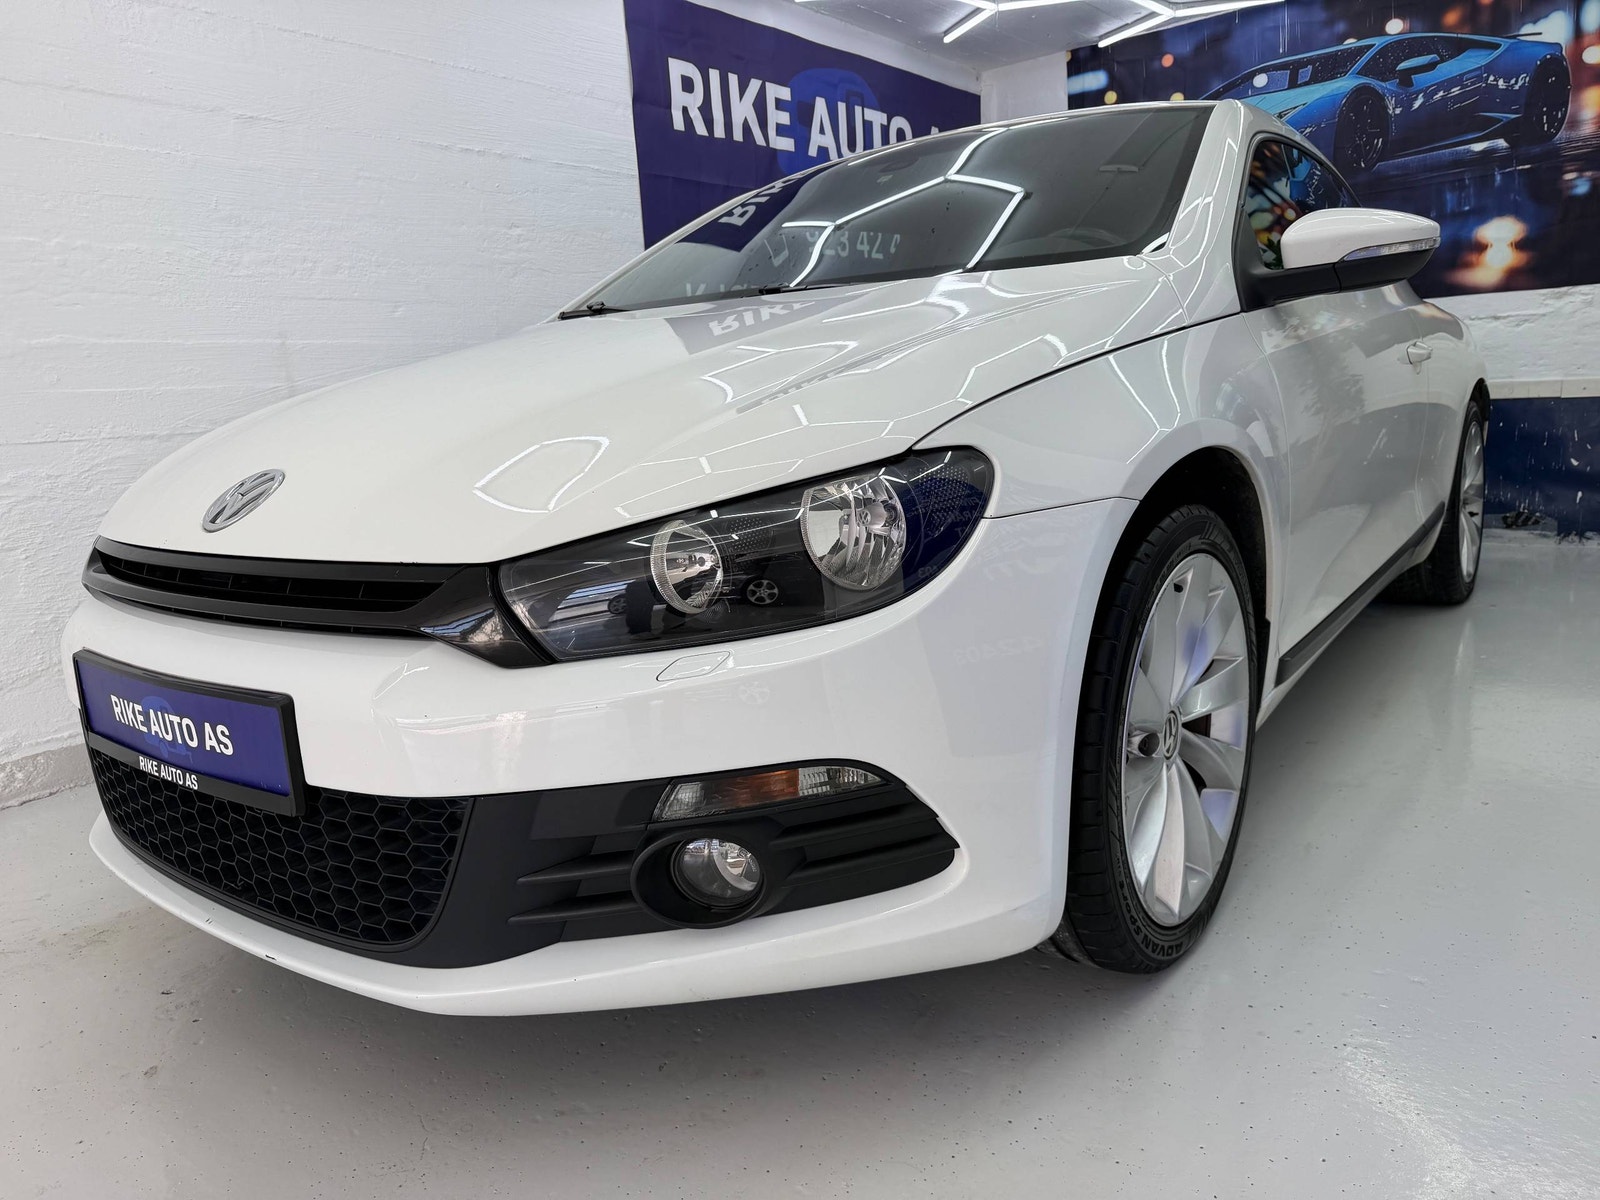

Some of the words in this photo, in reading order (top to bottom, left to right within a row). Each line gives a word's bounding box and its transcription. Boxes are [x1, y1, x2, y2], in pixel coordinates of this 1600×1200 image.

[668, 56, 795, 153] RIKE
[110, 694, 148, 733] RIKE
[150, 709, 199, 748] AUTO
[204, 722, 234, 756] AS
[139, 755, 160, 777] RIKE
[160, 764, 184, 786] AUTO
[185, 773, 198, 790] AS
[1141, 934, 1184, 957] ADVAN
